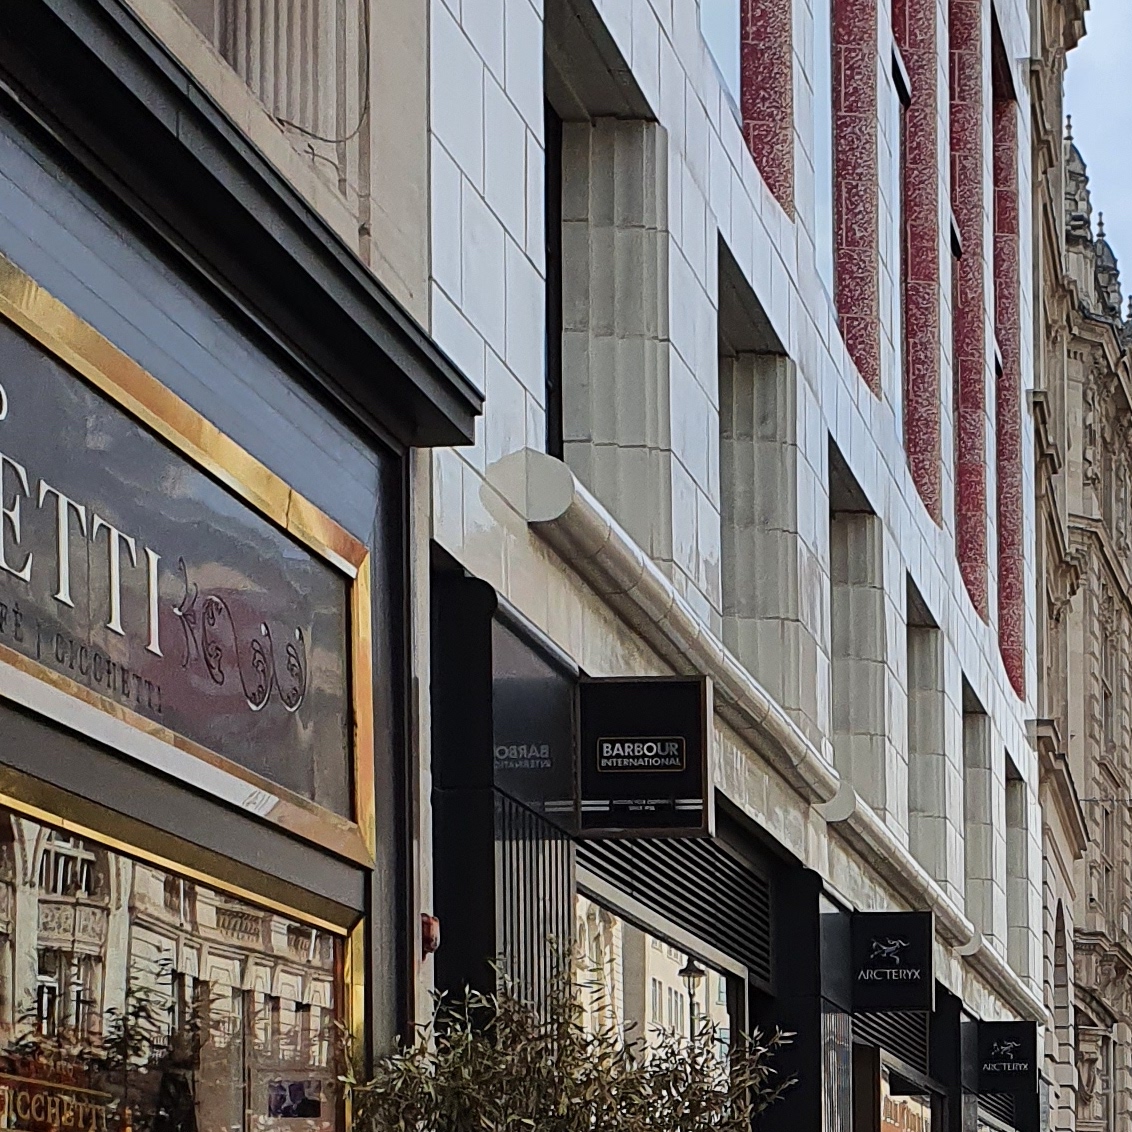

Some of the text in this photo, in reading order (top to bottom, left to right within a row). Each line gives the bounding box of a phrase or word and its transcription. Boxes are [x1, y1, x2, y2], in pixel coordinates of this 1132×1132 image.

[55, 632, 162, 713] CICCHETTI
[602, 742, 679, 757] BARBOUR
[601, 757, 682, 767] INTERNATIONAL
